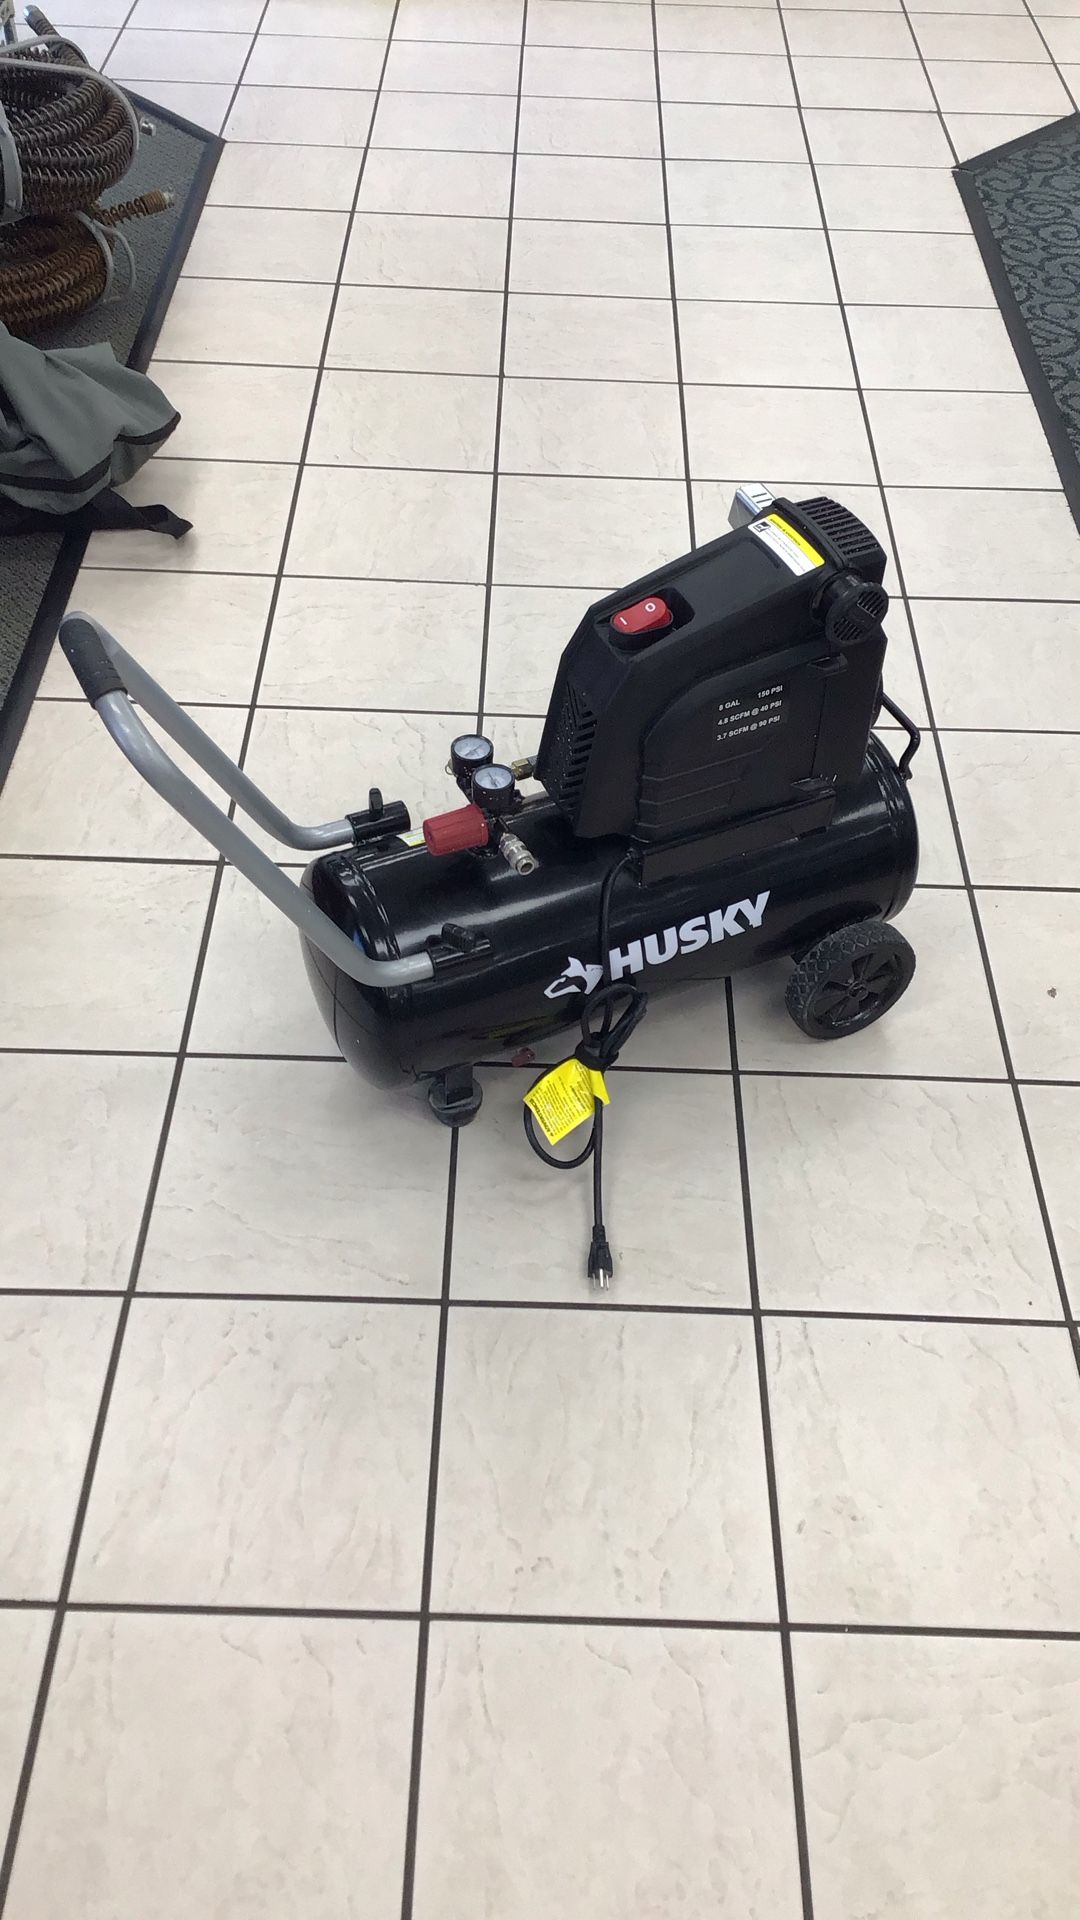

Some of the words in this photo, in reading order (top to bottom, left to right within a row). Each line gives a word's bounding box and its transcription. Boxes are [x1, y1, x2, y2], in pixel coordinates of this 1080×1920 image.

[725, 699, 741, 709] GAL
[758, 689, 770, 698] 150
[771, 685, 783, 694] PSI
[718, 717, 729, 726] 4.8
[730, 710, 751, 722] SCFM
[751, 707, 760, 716] @
[760, 704, 769, 712] 40
[770, 700, 782, 709] PSI
[717, 732, 728, 741] 3.7
[729, 725, 749, 737] SCFM
[750, 723, 758, 731] @
[758, 719, 768, 727] 90
[768, 715, 781, 724] PSI
[609, 890, 770, 981] HUSKY
